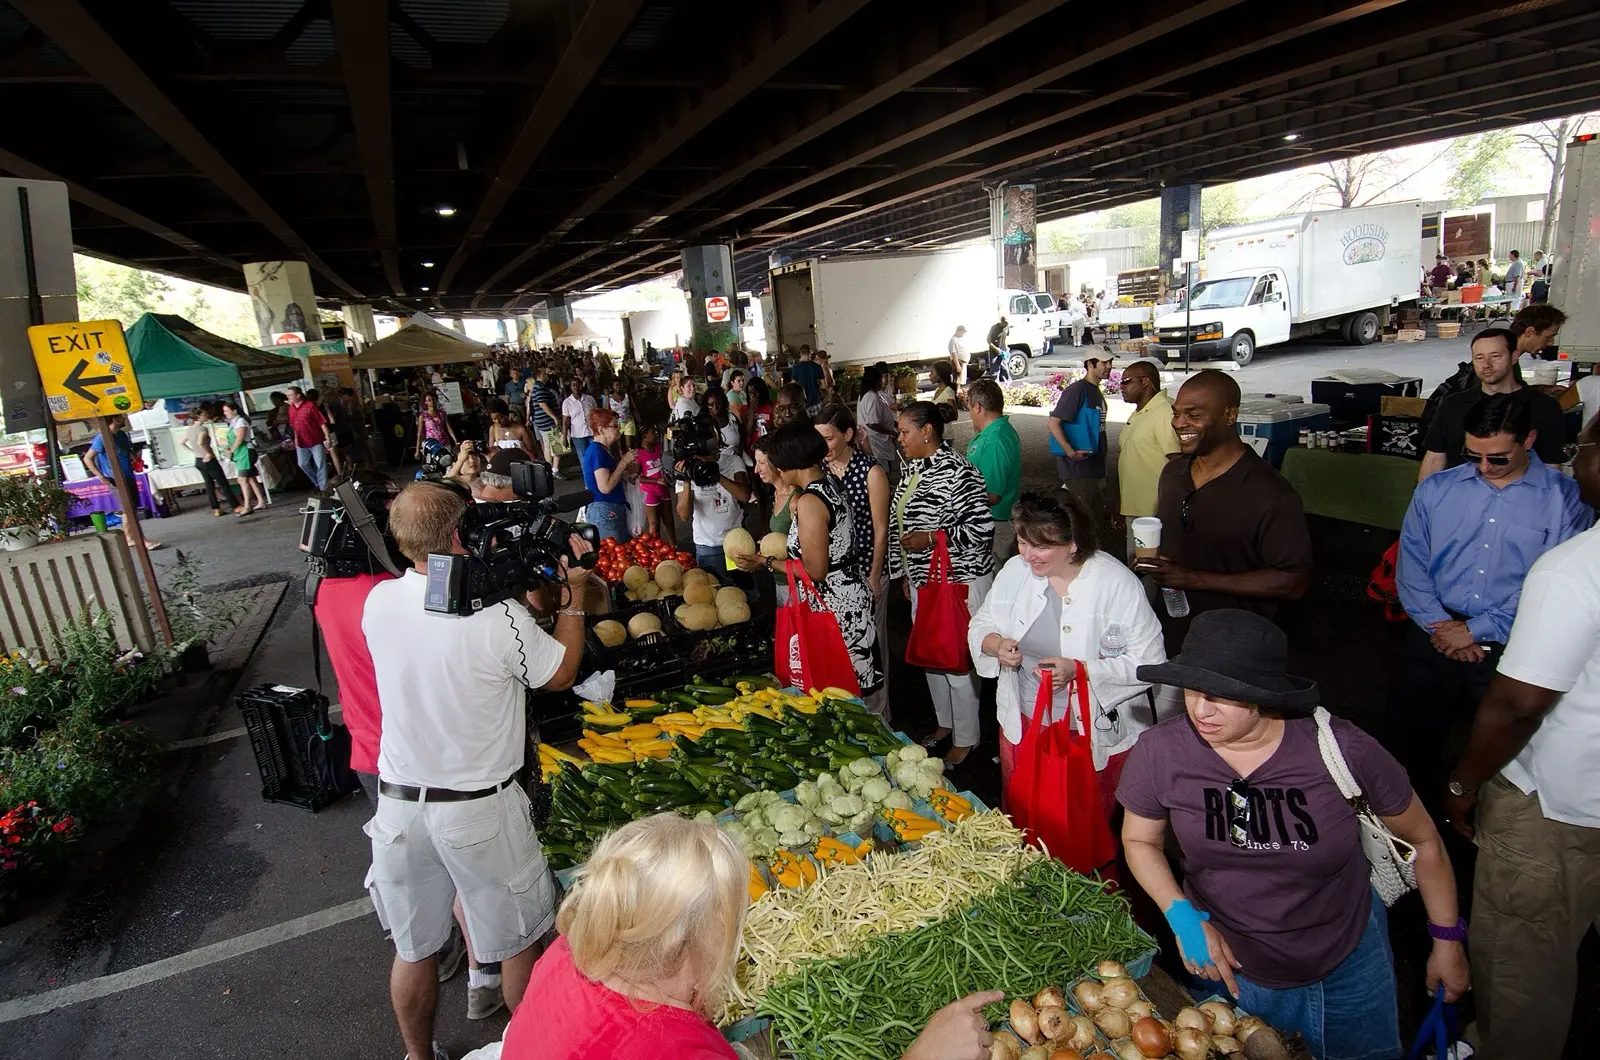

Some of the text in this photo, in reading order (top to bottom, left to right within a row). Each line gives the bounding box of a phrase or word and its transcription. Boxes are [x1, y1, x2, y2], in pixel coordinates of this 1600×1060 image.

[1340, 223, 1390, 247] WOODSIDE
[48, 332, 104, 354] EXIT
[1240, 839, 1310, 851] ince 73
